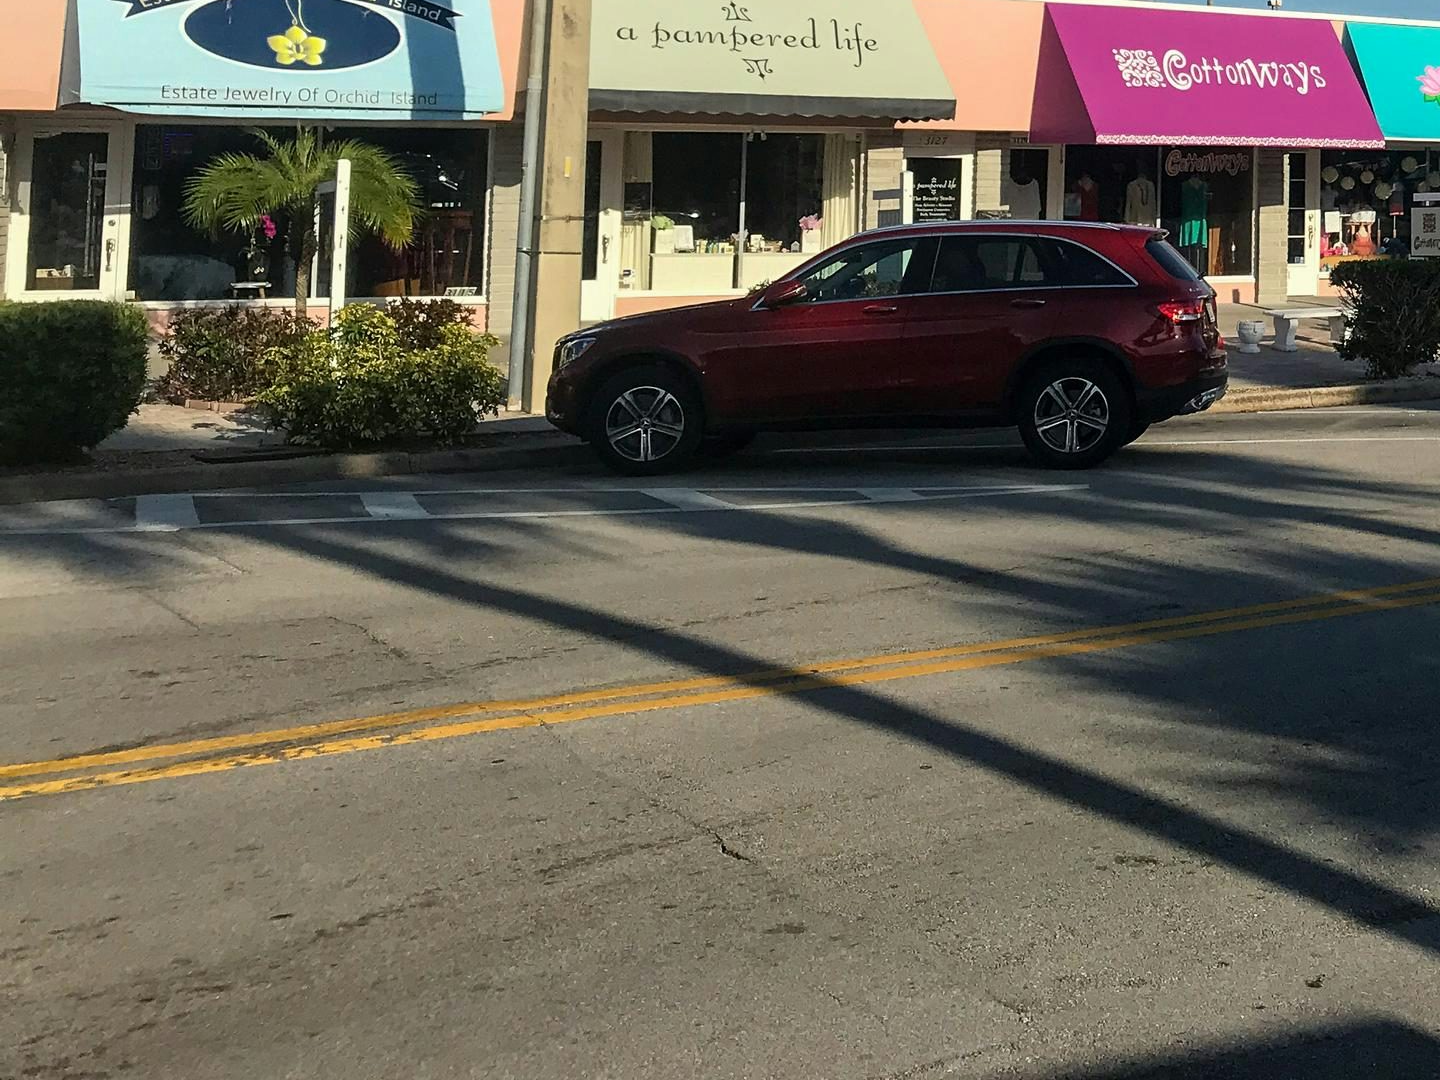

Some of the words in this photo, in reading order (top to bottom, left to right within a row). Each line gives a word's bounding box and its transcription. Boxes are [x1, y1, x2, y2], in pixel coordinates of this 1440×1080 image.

[616, 26, 638, 41] a
[651, 17, 820, 52] pampered
[830, 18, 879, 68] life
[161, 85, 217, 100] Estate
[223, 86, 292, 104] Jewelry
[298, 88, 319, 102] Of
[325, 89, 380, 104] Orchid
[391, 91, 437, 105] Island
[923, 136, 948, 145] 3127
